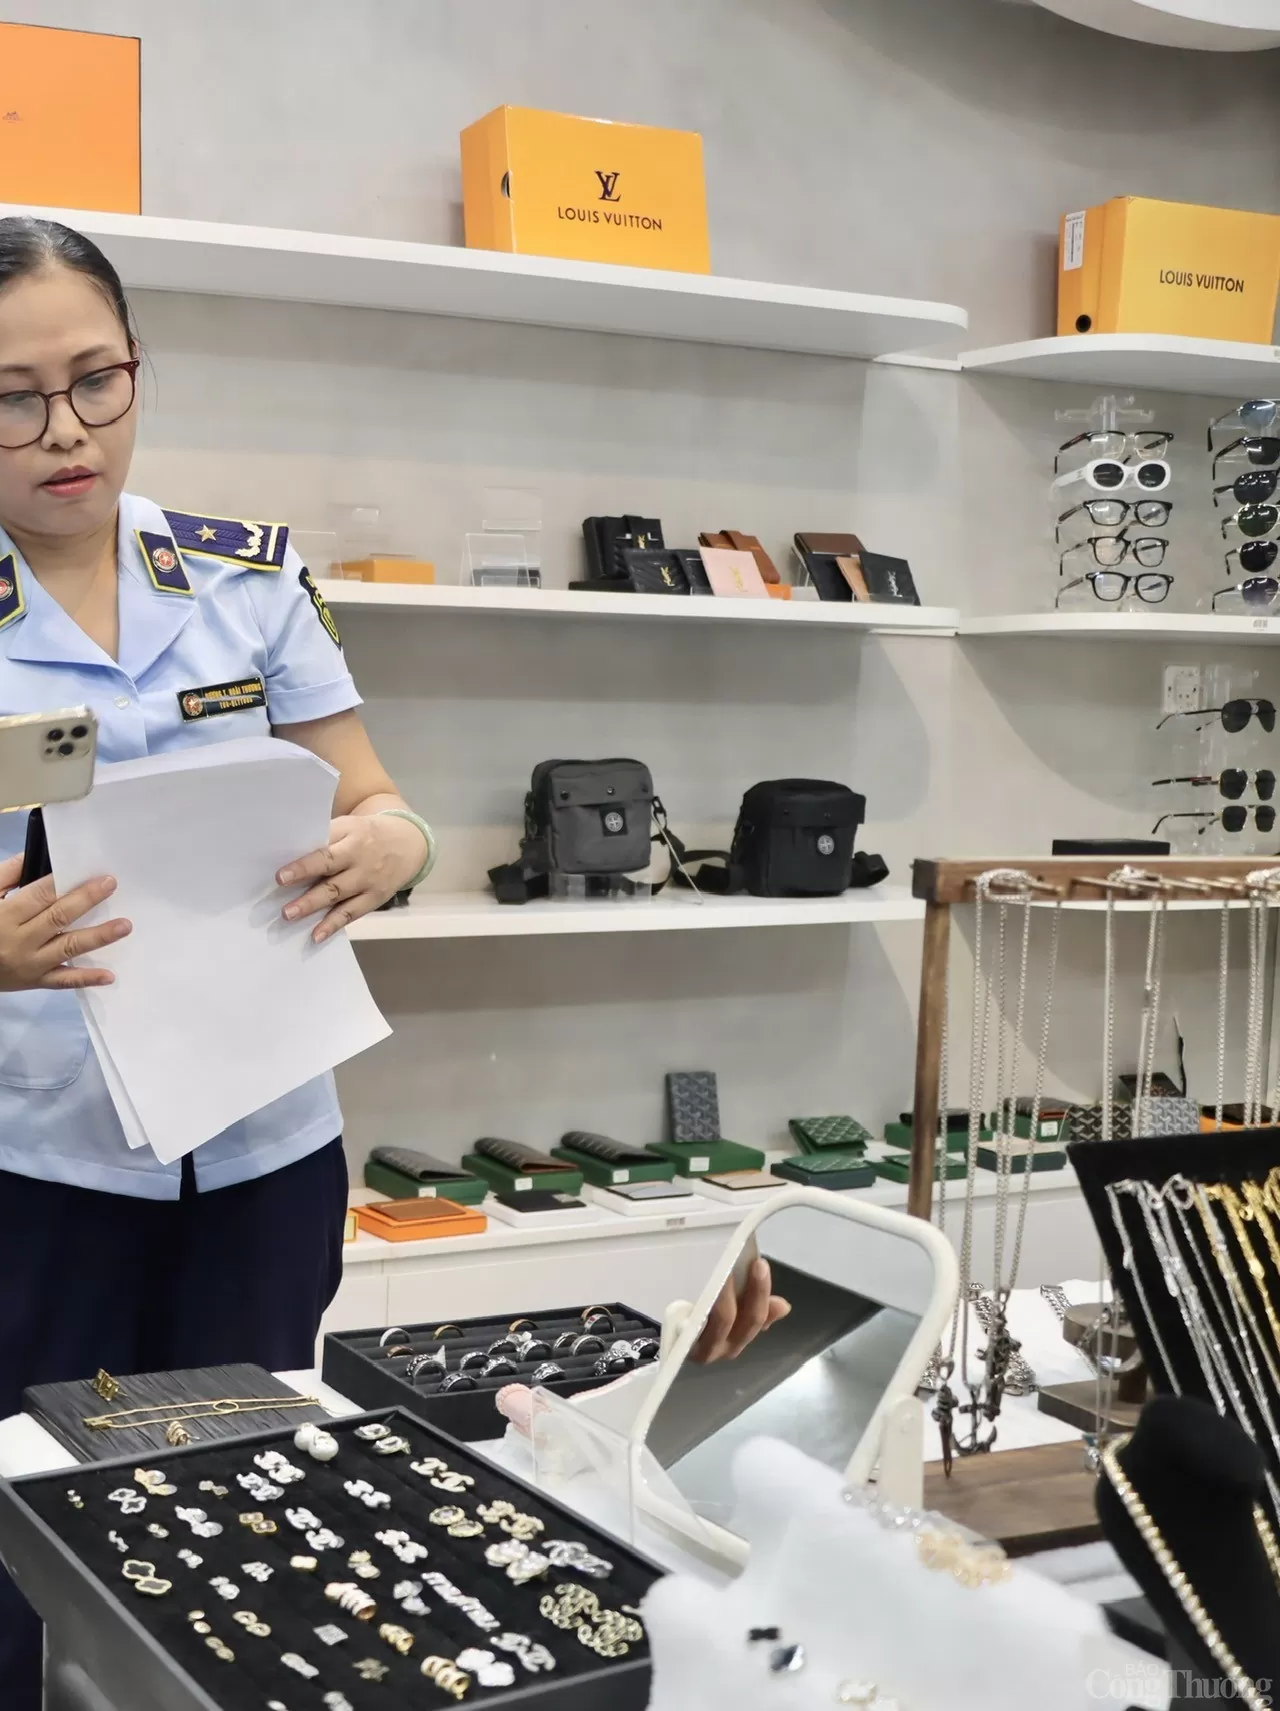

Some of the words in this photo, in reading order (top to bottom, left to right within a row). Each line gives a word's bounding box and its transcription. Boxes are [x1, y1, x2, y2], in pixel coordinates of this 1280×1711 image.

[557, 206, 600, 224] LOUIS
[603, 211, 663, 231] VUITTON
[1159, 269, 1194, 287] LOUIS
[1195, 273, 1245, 293] VUITTON
